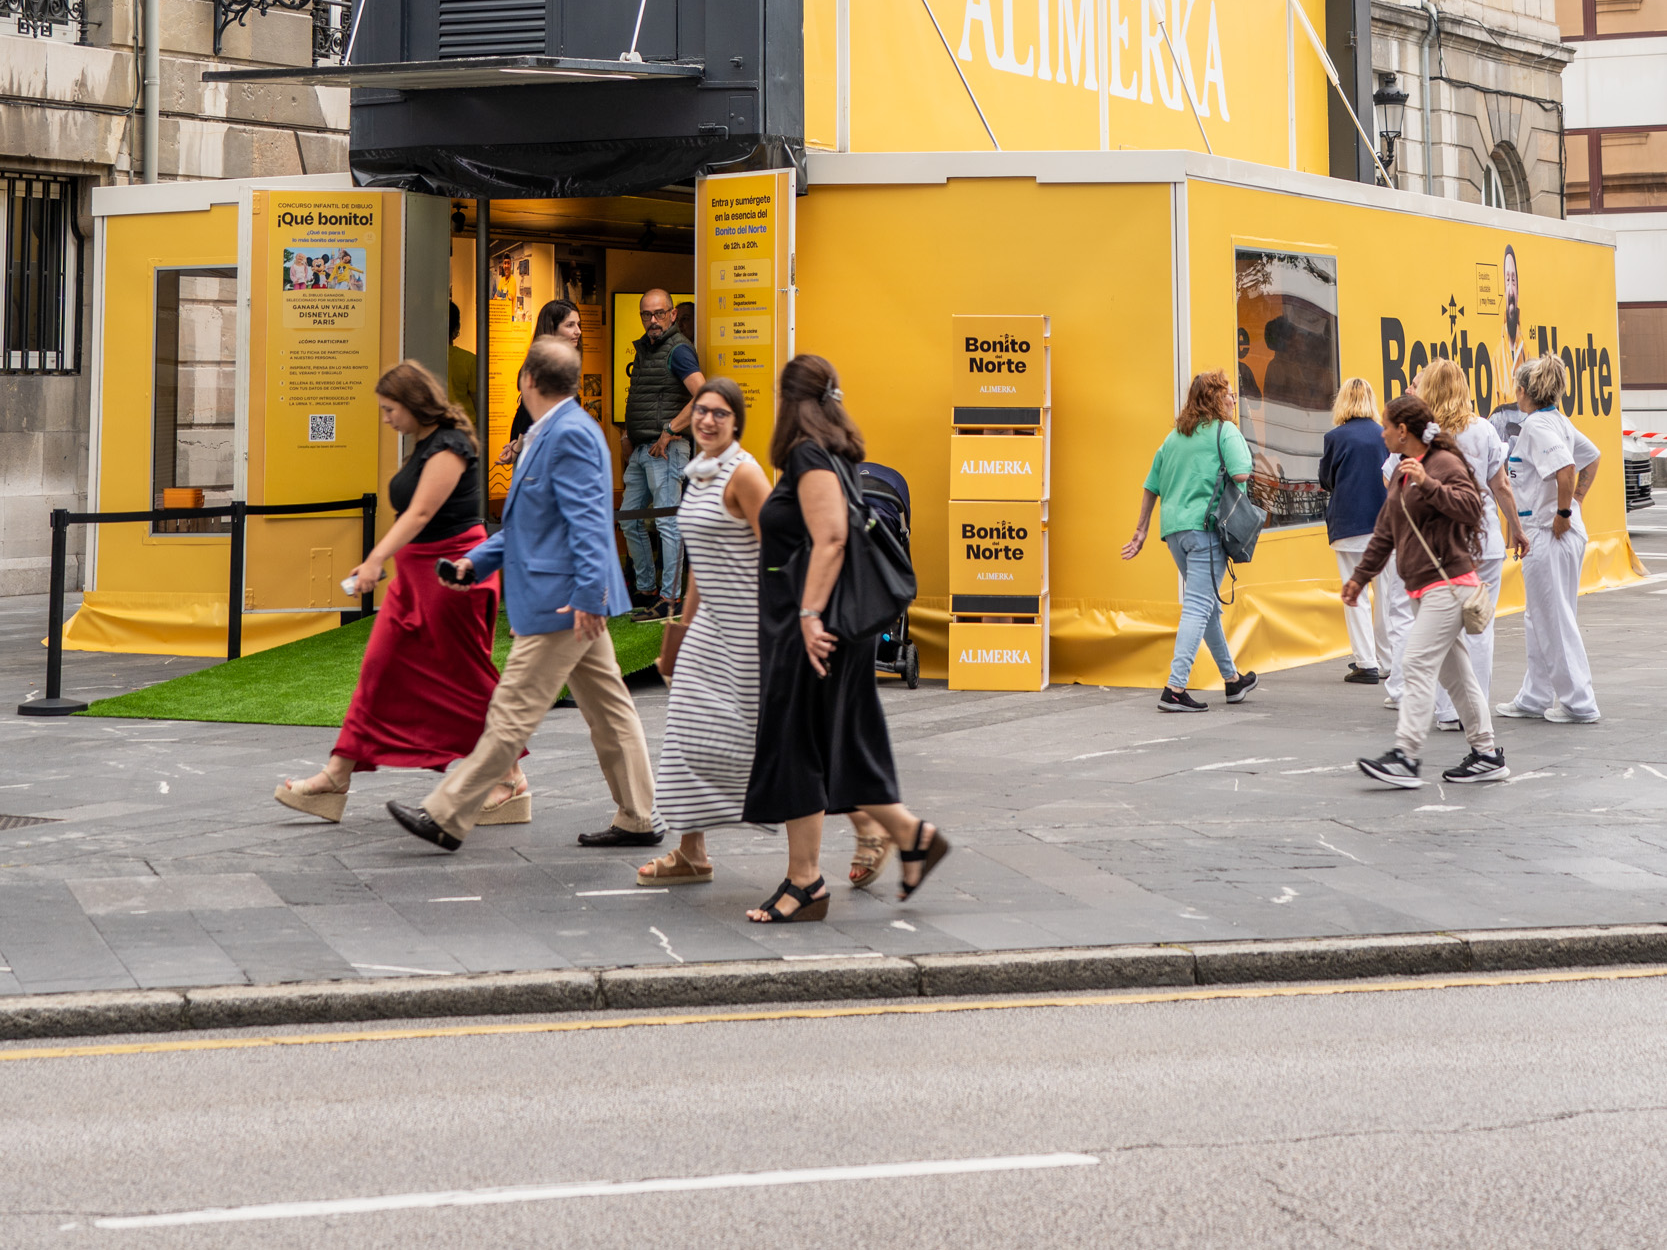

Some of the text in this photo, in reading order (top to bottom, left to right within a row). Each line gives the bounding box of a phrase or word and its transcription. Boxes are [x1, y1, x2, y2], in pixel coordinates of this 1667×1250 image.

[712, 195, 770, 208] Entra y sumérgete
[278, 212, 373, 227] ¡Qué bonito!
[724, 212, 730, 221] la
[731, 210, 756, 220] esencia
[758, 209, 767, 218] del
[715, 225, 767, 236] Bonito del Norte
[965, 334, 1030, 353] Bonito
[970, 358, 1026, 373] Norte
[960, 460, 1032, 474] ALIMERKA
[962, 520, 1028, 540] Bonito
[966, 544, 1024, 560] Norte
[959, 650, 1031, 664] ALIMERKA
